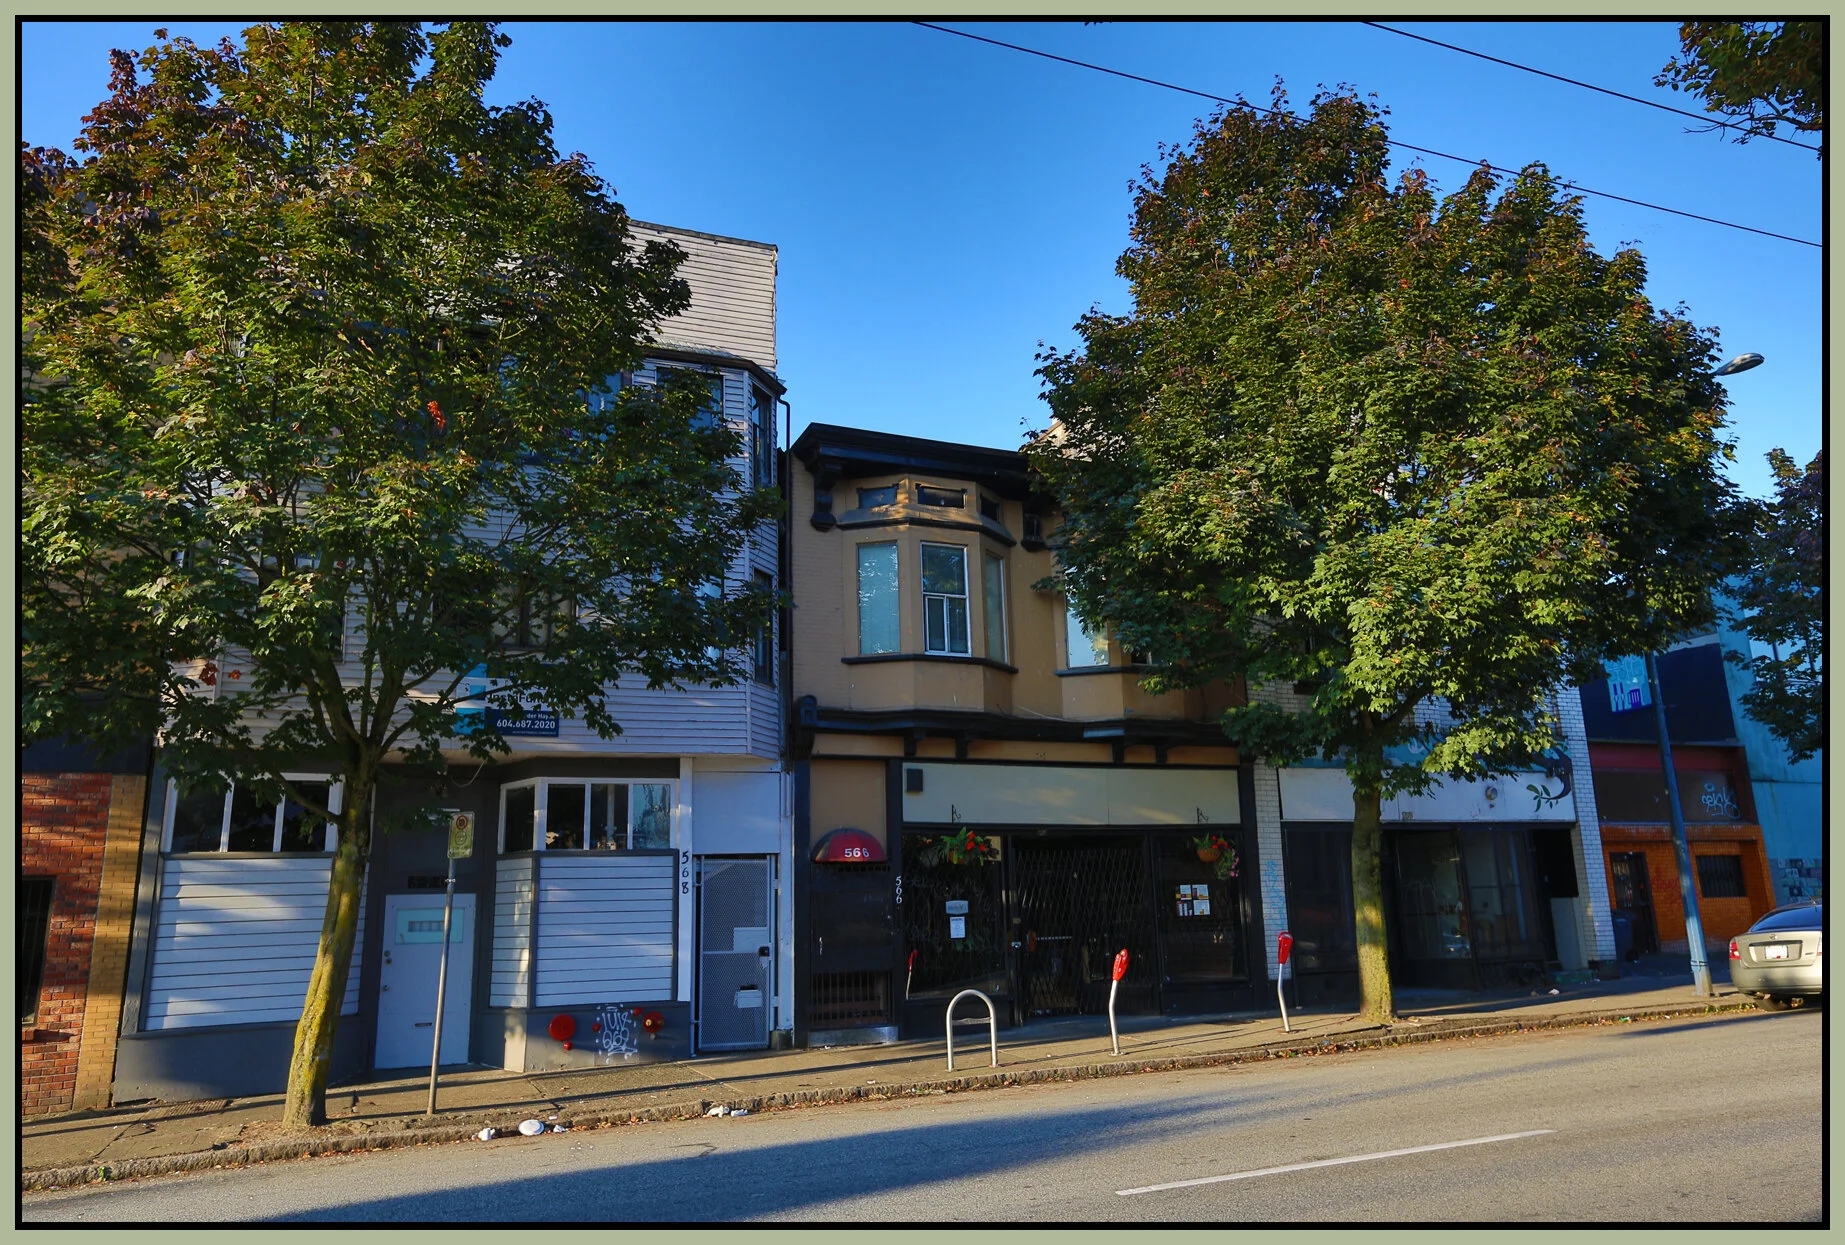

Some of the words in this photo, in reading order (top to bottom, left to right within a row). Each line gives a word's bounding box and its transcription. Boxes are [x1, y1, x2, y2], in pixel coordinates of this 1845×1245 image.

[496, 719, 556, 729] 604.687.2020
[844, 847, 870, 858] 566
[681, 850, 690, 895] 568
[895, 875, 903, 904] 566
